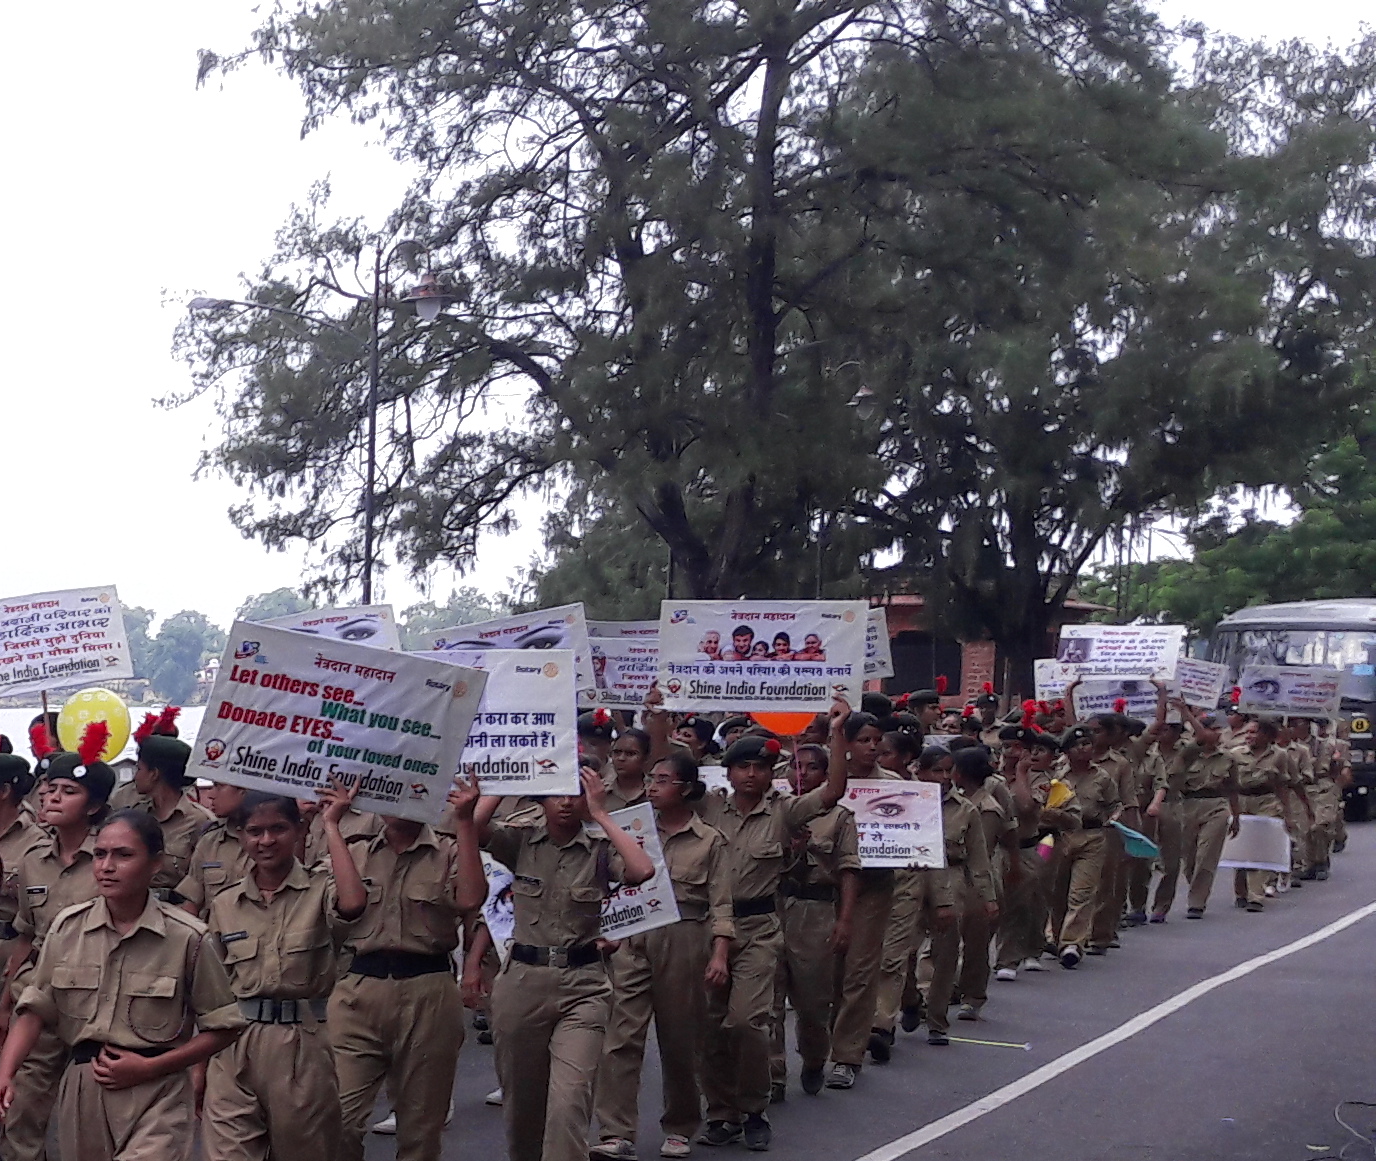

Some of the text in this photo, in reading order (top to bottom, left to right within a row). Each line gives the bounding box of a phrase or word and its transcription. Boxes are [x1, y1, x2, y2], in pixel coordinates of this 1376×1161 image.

[55, 616, 110, 631] आभार
[4, 636, 40, 652] जिससे
[70, 630, 106, 644] दुनिया
[27, 651, 43, 659] का
[82, 642, 112, 653] मिला
[13, 664, 40, 679] India
[42, 657, 100, 675] Foundation
[314, 652, 397, 683] नेत्रदान महादान
[668, 661, 699, 674] नेत्रदान
[718, 663, 743, 675] अपने
[229, 664, 259, 685] Let
[260, 672, 319, 697] others
[689, 680, 826, 696] Shine India Foundation
[217, 701, 287, 730] Donate
[320, 700, 367, 725] What
[368, 712, 399, 731] you
[485, 712, 508, 725] करा
[510, 712, 529, 725] कर
[532, 712, 556, 725] आप
[489, 734, 507, 747] ला
[508, 731, 539, 748] सकते
[234, 746, 277, 772] Shine
[282, 755, 322, 780] India
[307, 740, 439, 775] of your loved ones
[455, 754, 529, 775] undation
[859, 843, 911, 855] oundation
